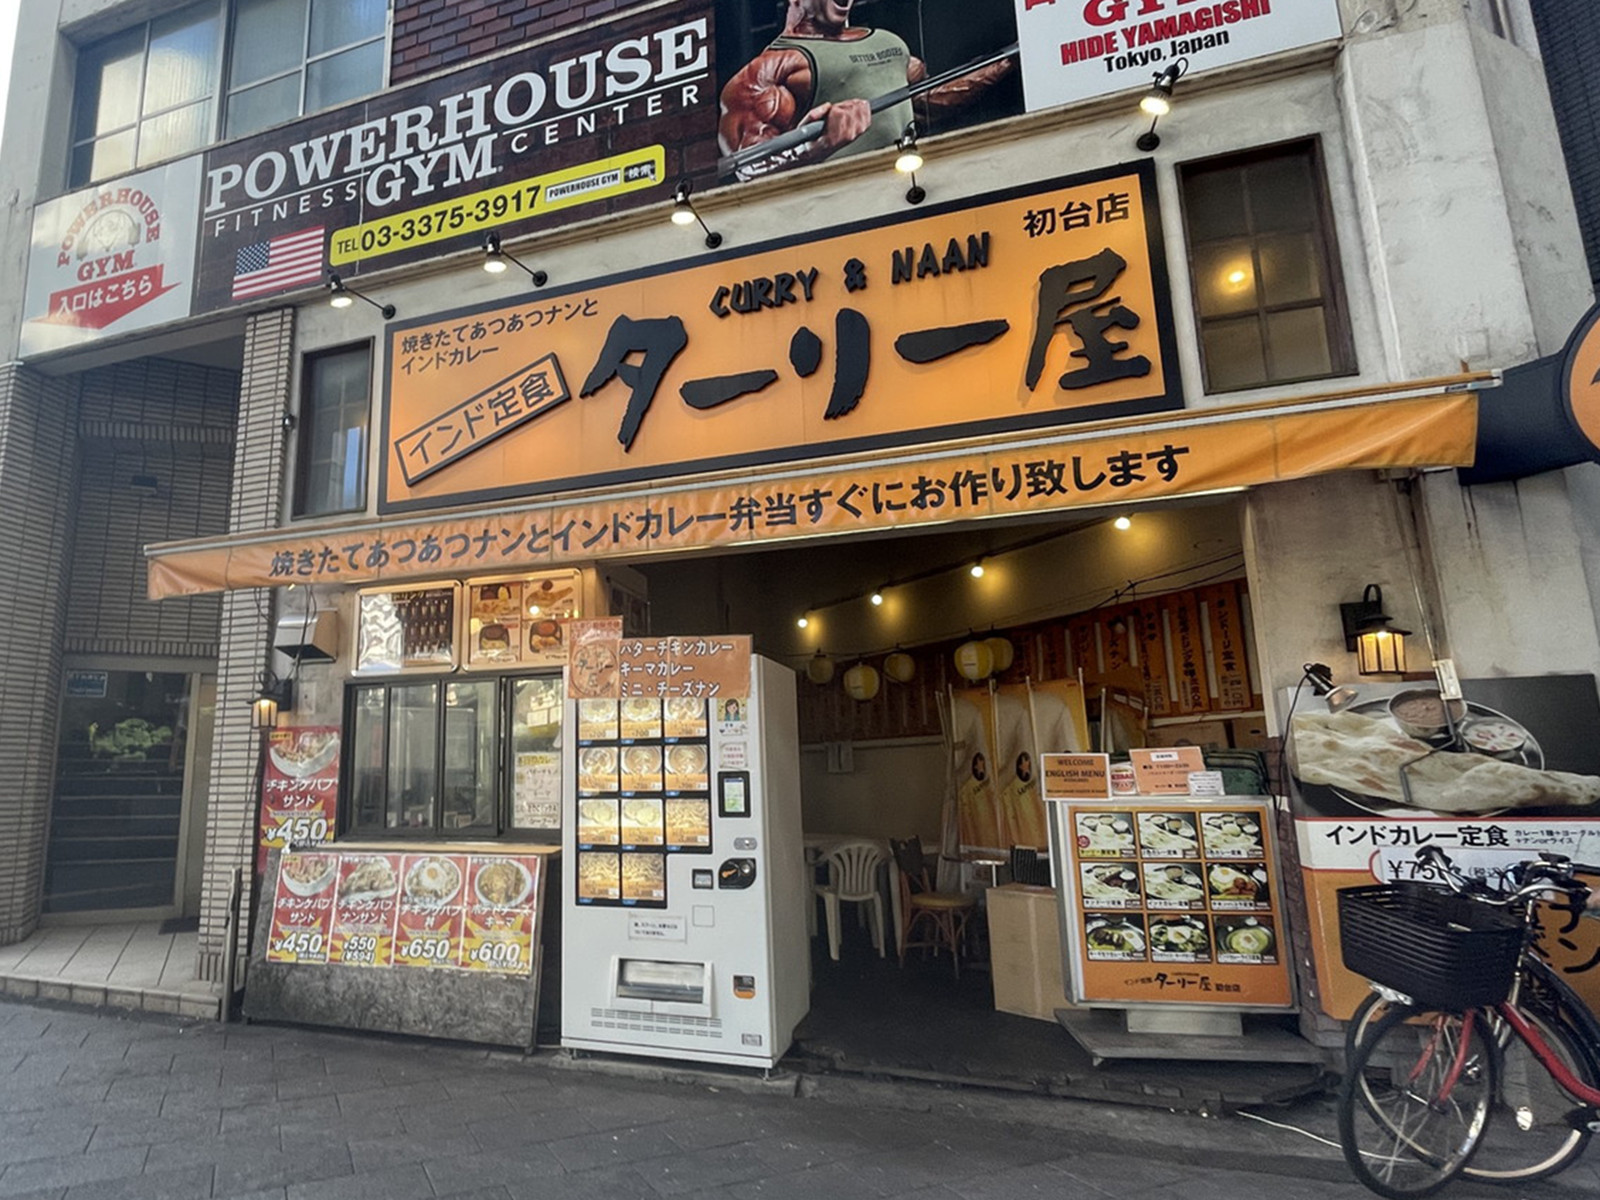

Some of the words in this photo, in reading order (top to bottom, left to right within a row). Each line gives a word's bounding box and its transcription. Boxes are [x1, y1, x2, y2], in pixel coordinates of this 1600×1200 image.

[1061, 32, 1118, 66] HIDE
[1121, 0, 1271, 48] YAMAGISHI
[1104, 45, 1166, 73] Tokyo,
[1170, 30, 1230, 58] Japan
[205, 18, 707, 213] POWERHOUSE
[511, 85, 698, 153] CENTER
[366, 133, 499, 207] GYM
[549, 178, 600, 197] POWERHOUSE
[601, 173, 618, 185] GYM
[57, 188, 160, 268] POWERHOUSE
[215, 182, 357, 237] FITNESS
[338, 238, 358, 254] TEL
[361, 186, 540, 251] 03-3375-3917
[1023, 192, 1130, 238] 初台店
[77, 249, 135, 281] GYM
[709, 267, 819, 318] CURRY
[843, 257, 867, 292] &
[892, 231, 990, 285] NAAN
[57, 274, 152, 317] 入口はこちら
[401, 298, 598, 354] 焼きたてあつあつナンと
[401, 346, 499, 376] インドカレー
[579, 248, 1151, 453] ターリー屋
[409, 371, 555, 464] インド定食
[269, 444, 1190, 578] 焼きたてあつあつナンとインドカレー弁当すぐにお作り致します
[620, 641, 733, 657] バターチキンカレー
[620, 662, 694, 677] キーマカレー
[283, 795, 315, 808] サンド
[267, 818, 327, 841] ¥450
[1326, 824, 1511, 848] インドカレー定食
[1388, 860, 1450, 881] ¥75
[290, 912, 316, 923] サンド
[274, 932, 324, 953] ¥450
[343, 936, 377, 950] ¥550
[401, 939, 450, 959] ¥650
[470, 942, 521, 962] ¥600
[1154, 972, 1212, 992] ターリー屋
